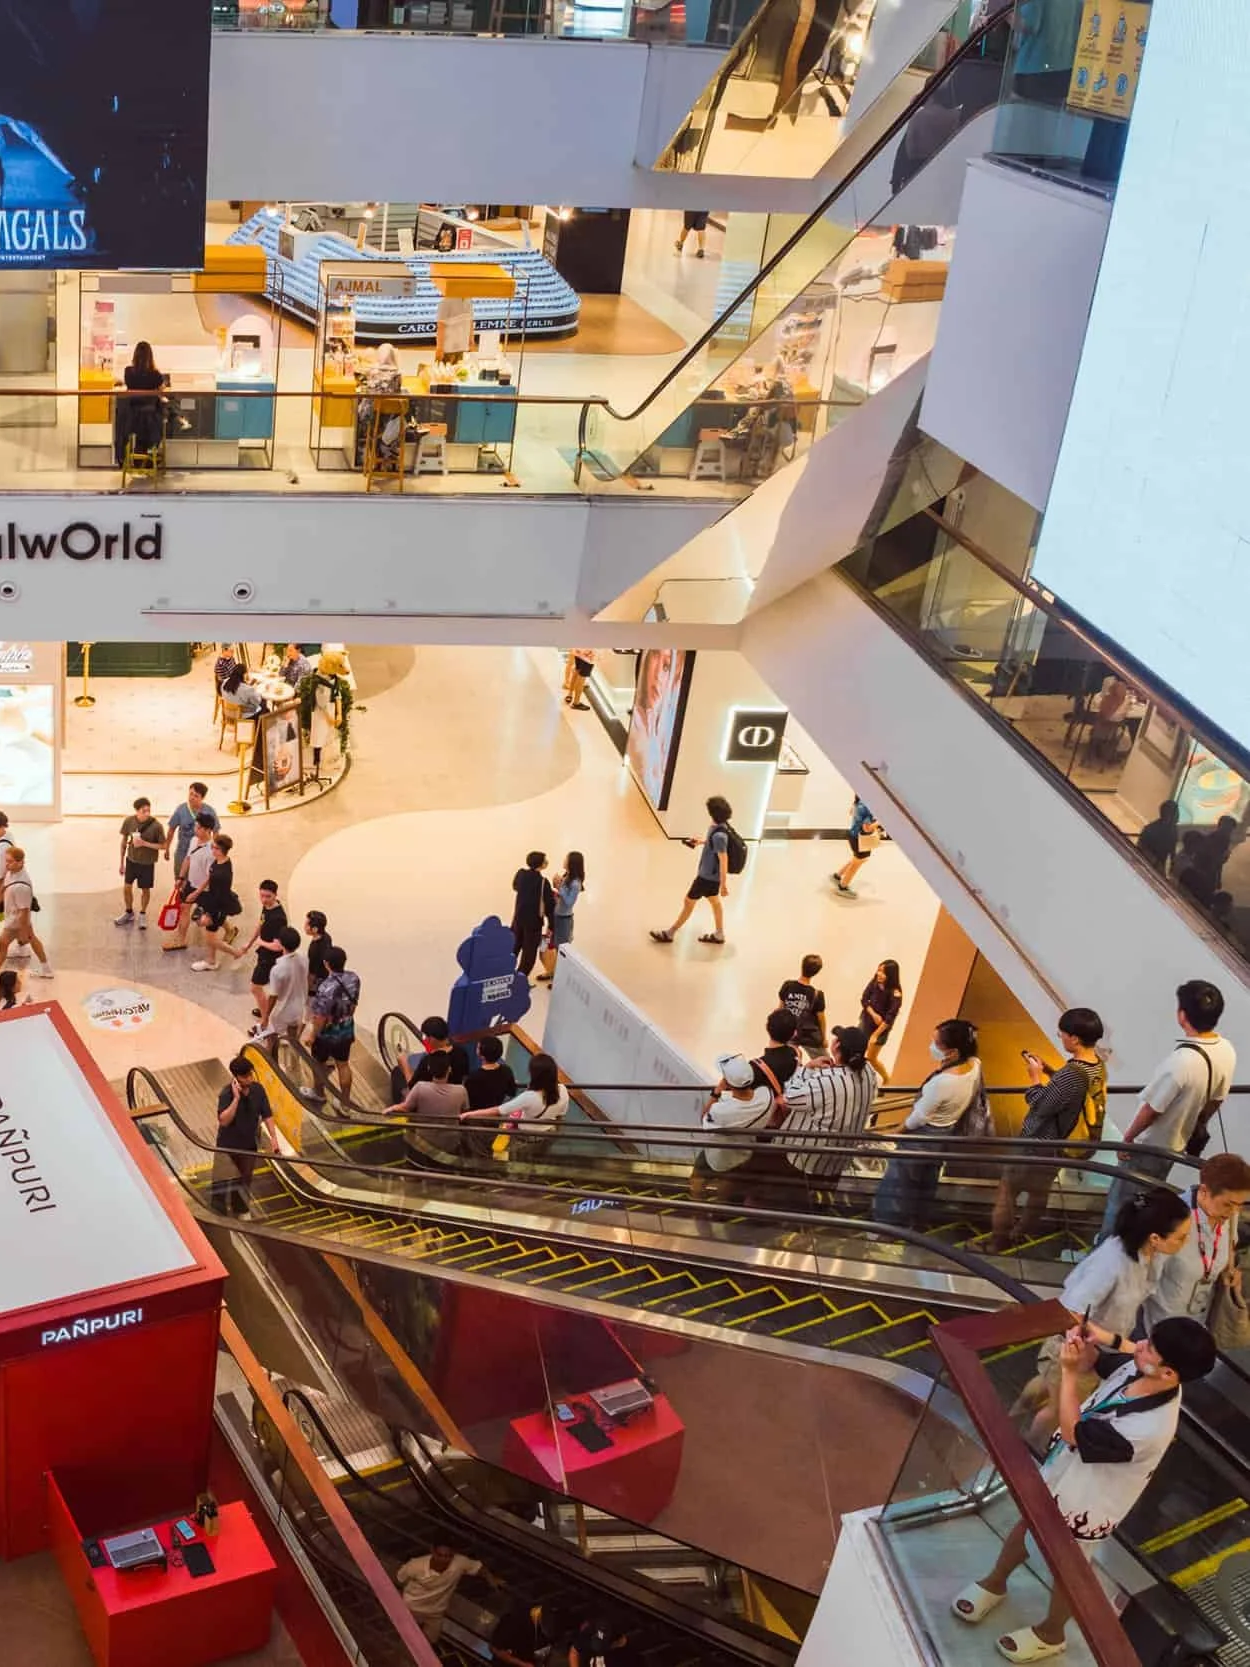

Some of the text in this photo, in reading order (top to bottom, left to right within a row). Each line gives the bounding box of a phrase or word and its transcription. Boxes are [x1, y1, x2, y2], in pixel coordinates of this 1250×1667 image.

[334, 281, 383, 293] AJMAL
[398, 323, 437, 333] CARO
[41, 1308, 143, 1346] PAÑPURI
